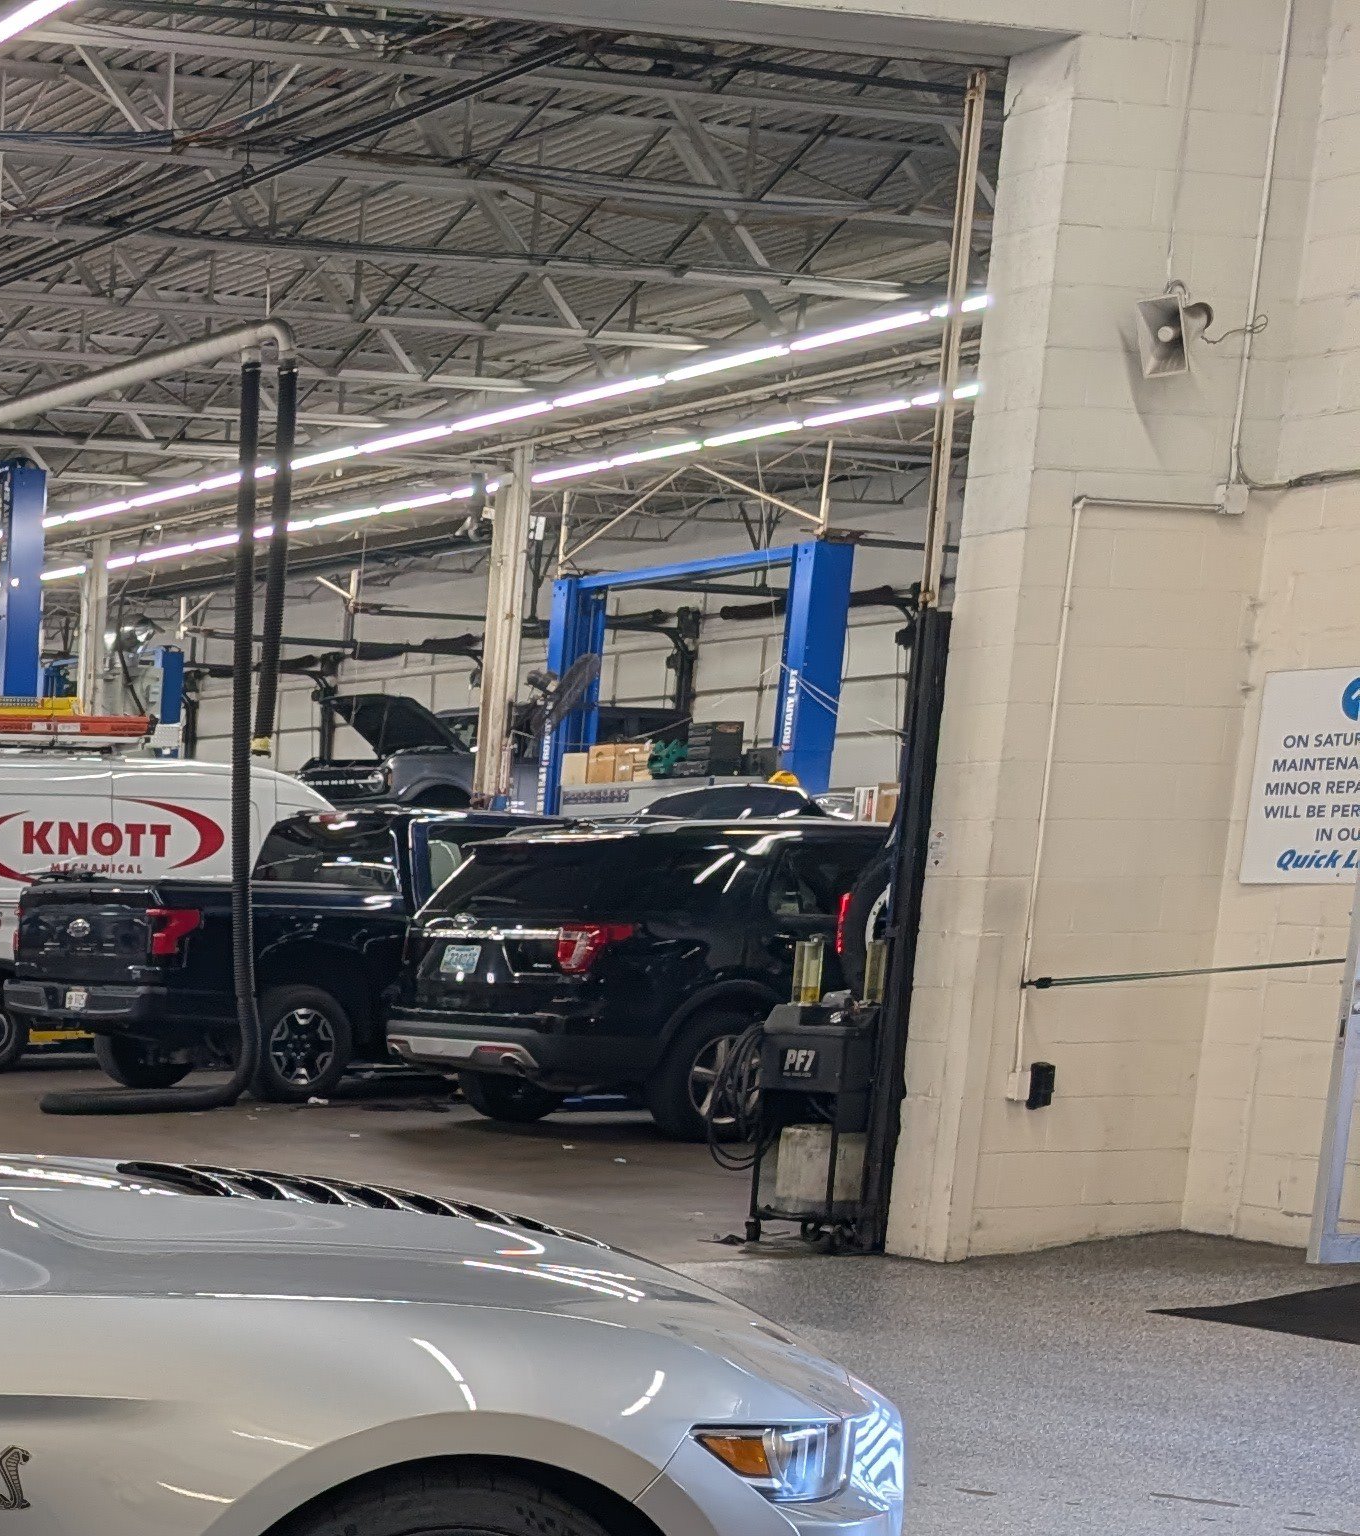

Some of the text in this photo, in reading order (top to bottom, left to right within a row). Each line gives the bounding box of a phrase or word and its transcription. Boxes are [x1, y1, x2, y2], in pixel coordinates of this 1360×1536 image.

[1283, 734, 1310, 749] ON
[1272, 756, 1360, 773] MAINTENA
[1264, 781, 1321, 796] MINOR
[1264, 804, 1301, 819] WILL
[1306, 804, 1327, 818] BE
[22, 820, 172, 858] KNOTT
[1315, 827, 1333, 842] IN
[1275, 849, 1343, 872] Quick
[783, 1048, 816, 1072] PF7
